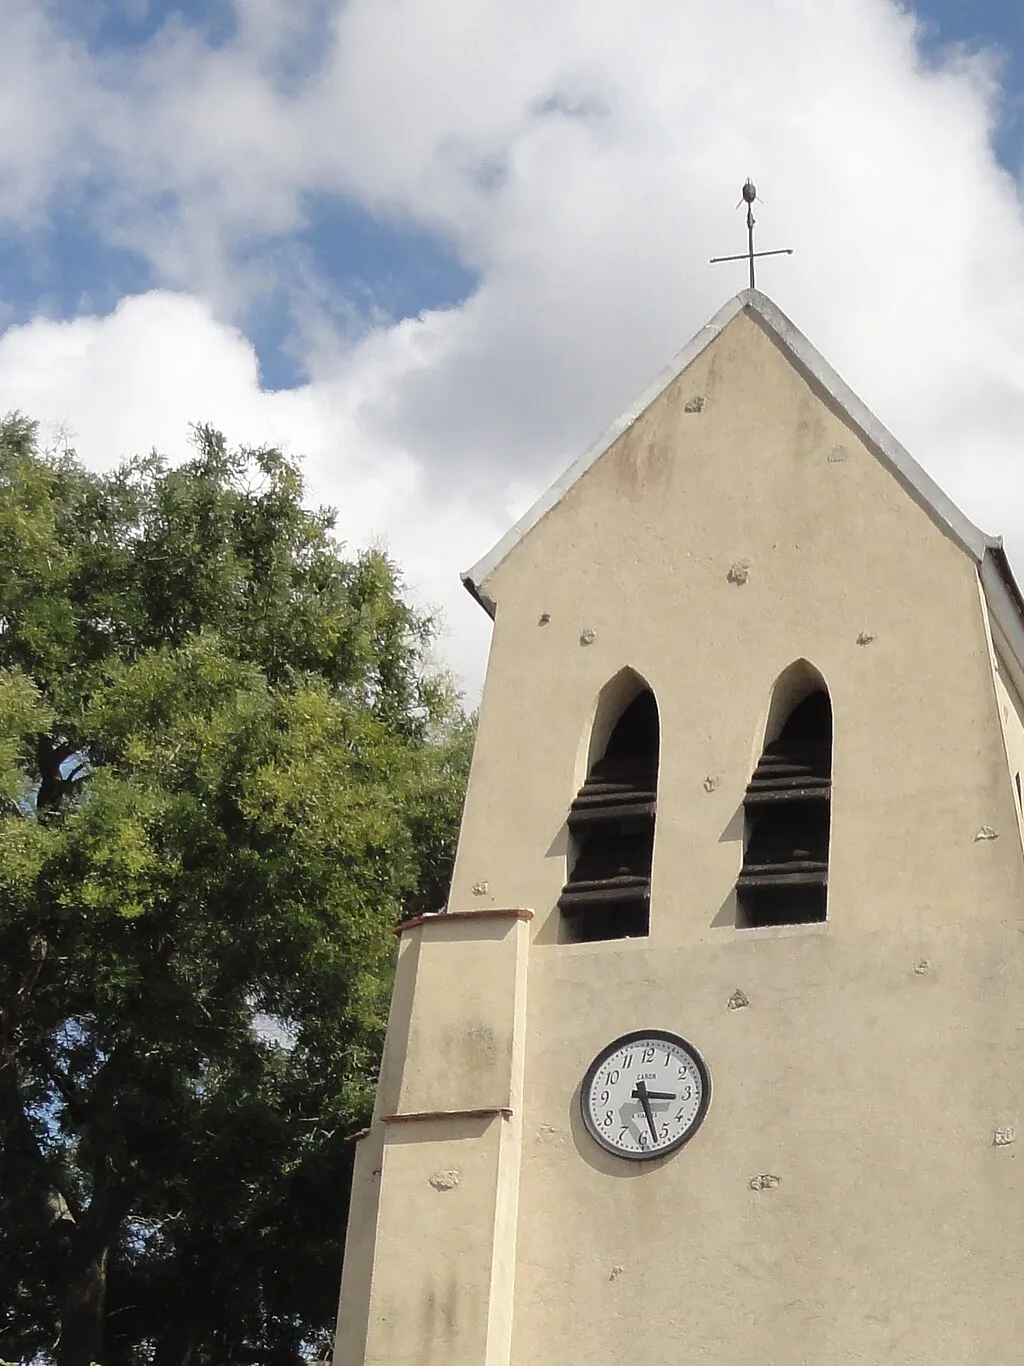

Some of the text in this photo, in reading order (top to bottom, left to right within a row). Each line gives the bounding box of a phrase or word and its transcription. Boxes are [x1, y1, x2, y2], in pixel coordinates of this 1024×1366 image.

[622, 1054, 633, 1069] 11
[641, 1048, 655, 1063] 12
[664, 1052, 671, 1067] 1
[605, 1070, 620, 1086] 10
[678, 1066, 687, 1080] 2
[600, 1090, 609, 1107] 9
[682, 1086, 691, 1101] 3
[604, 1110, 613, 1126] 8
[674, 1107, 684, 1122] 4
[619, 1126, 629, 1141] 7
[638, 1130, 648, 1145] 6
[659, 1122, 670, 1138] 5
